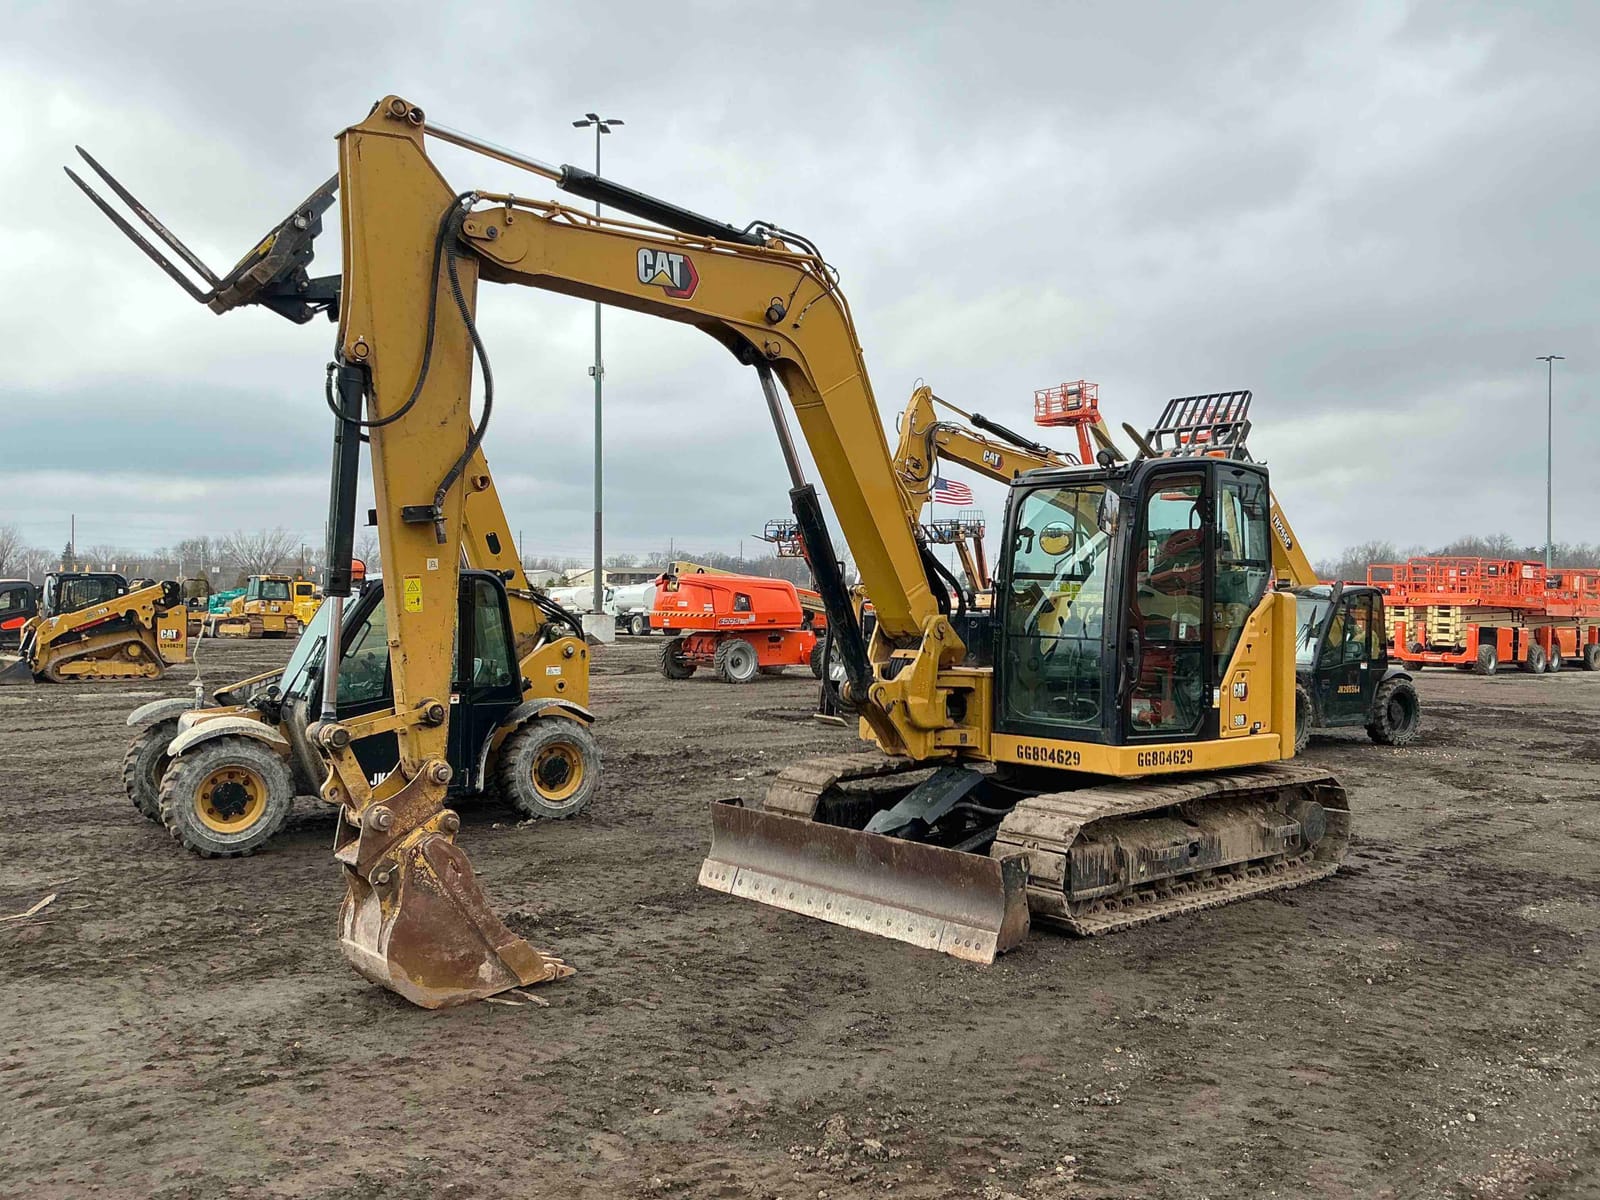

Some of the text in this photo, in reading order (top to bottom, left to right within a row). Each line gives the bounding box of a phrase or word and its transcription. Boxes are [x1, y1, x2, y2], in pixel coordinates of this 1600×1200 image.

[637, 248, 684, 288] CAT
[983, 450, 1000, 466] CAT
[161, 629, 178, 640] CAT
[1233, 682, 1246, 698] CAT
[1016, 744, 1081, 766] GG804629
[1137, 749, 1193, 767] GG804629
